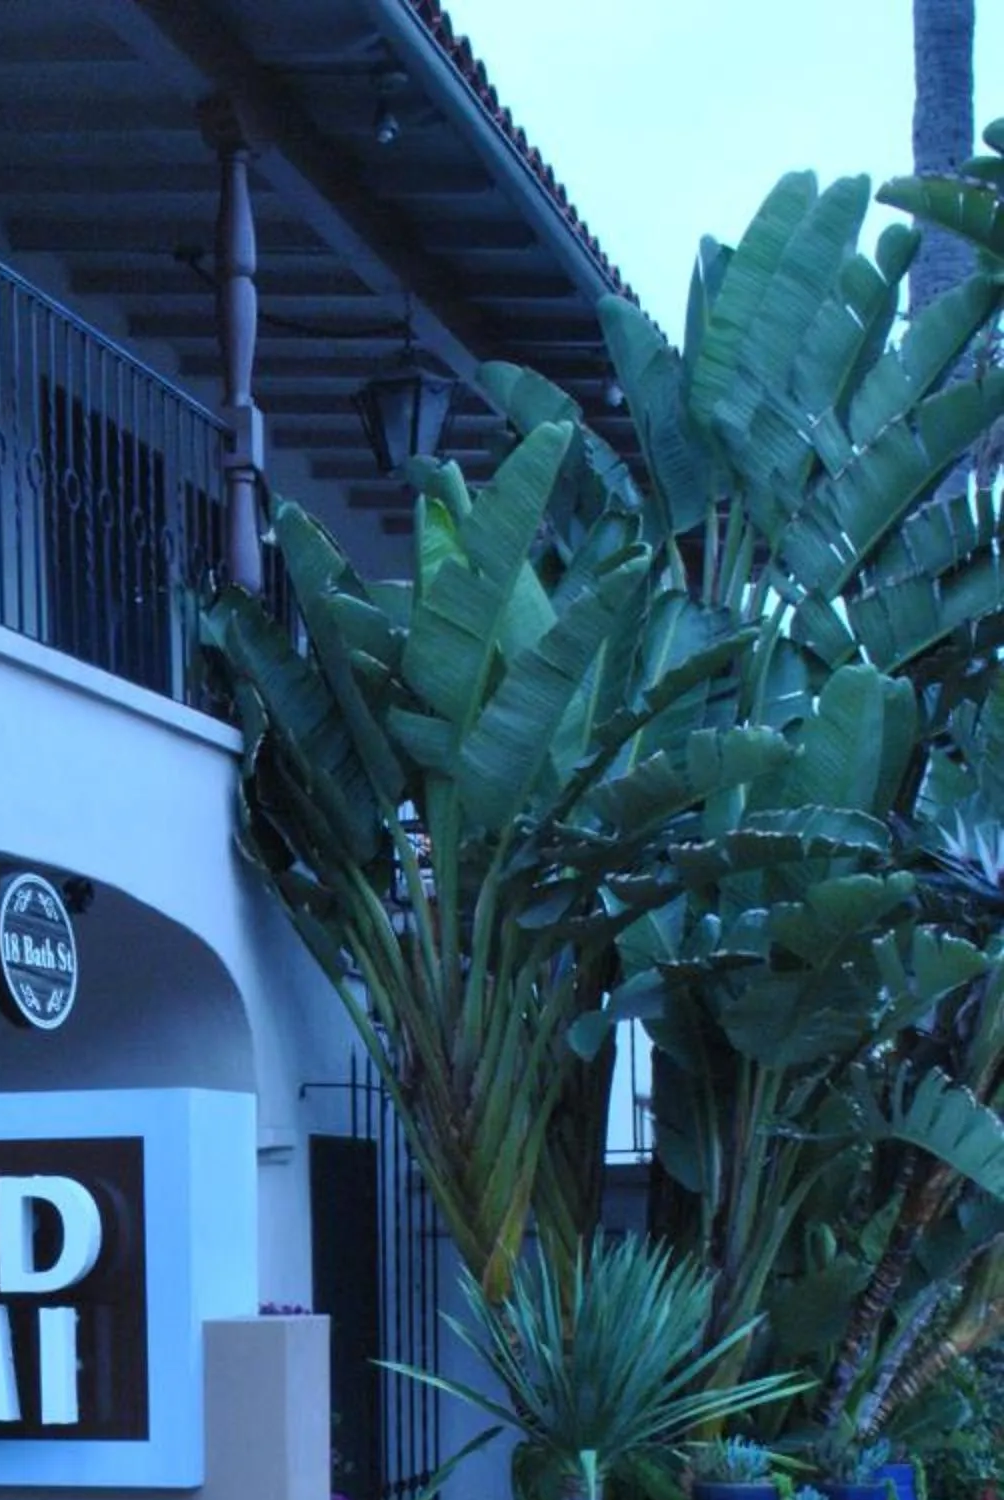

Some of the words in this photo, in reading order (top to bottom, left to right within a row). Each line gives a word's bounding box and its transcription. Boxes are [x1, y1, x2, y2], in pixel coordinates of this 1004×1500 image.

[3, 931, 20, 963] 18
[23, 934, 55, 969] Bath
[57, 941, 73, 973] St
